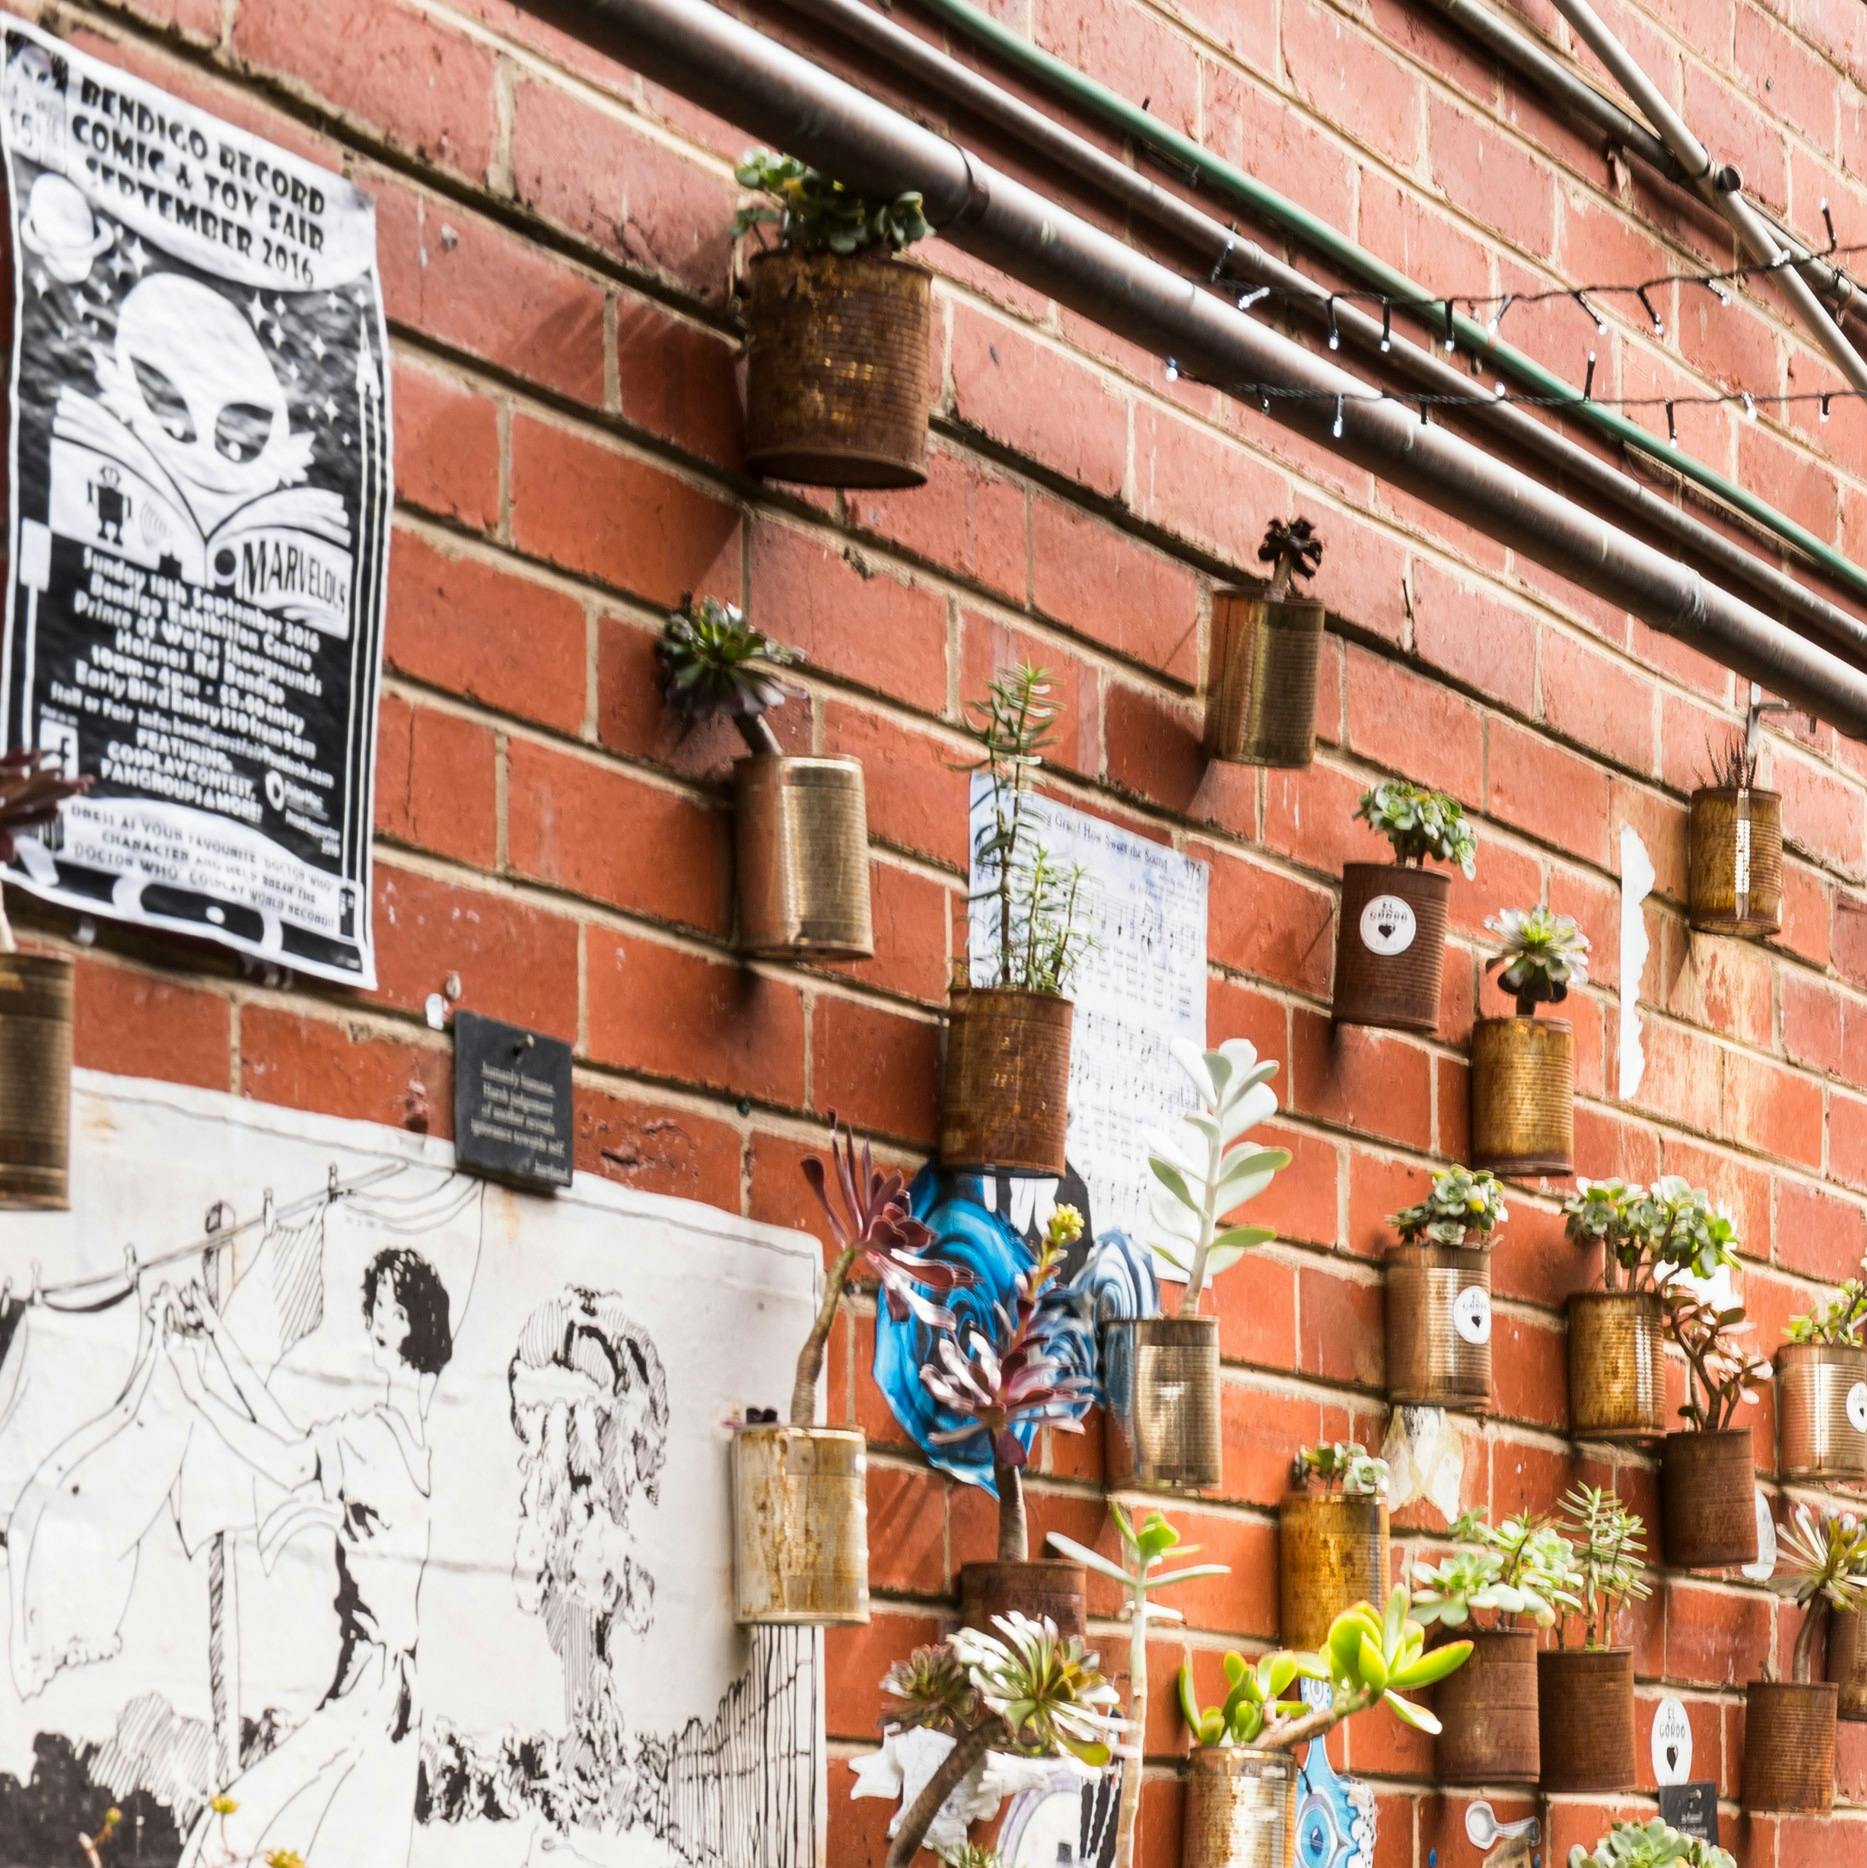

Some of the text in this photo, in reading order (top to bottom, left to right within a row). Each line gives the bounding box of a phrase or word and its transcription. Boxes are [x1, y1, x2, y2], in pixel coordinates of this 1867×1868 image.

[72, 115, 165, 174] COMIC
[176, 162, 193, 191] &
[204, 174, 258, 216] TOY
[269, 204, 325, 254] FAIR
[81, 75, 208, 160] BENDIGO
[218, 143, 325, 215] RECORD
[86, 157, 315, 286] SEPTEMBER 2016
[84, 545, 146, 593] Sunday
[192, 588, 282, 635] September
[285, 622, 320, 653] 2016
[90, 572, 312, 672] Bendigo Exhibition Centre
[242, 538, 346, 614] MARVELOUS
[74, 589, 322, 696] Prince of Wales Showgrounds
[115, 629, 285, 705] Holmes Rd Bendigo
